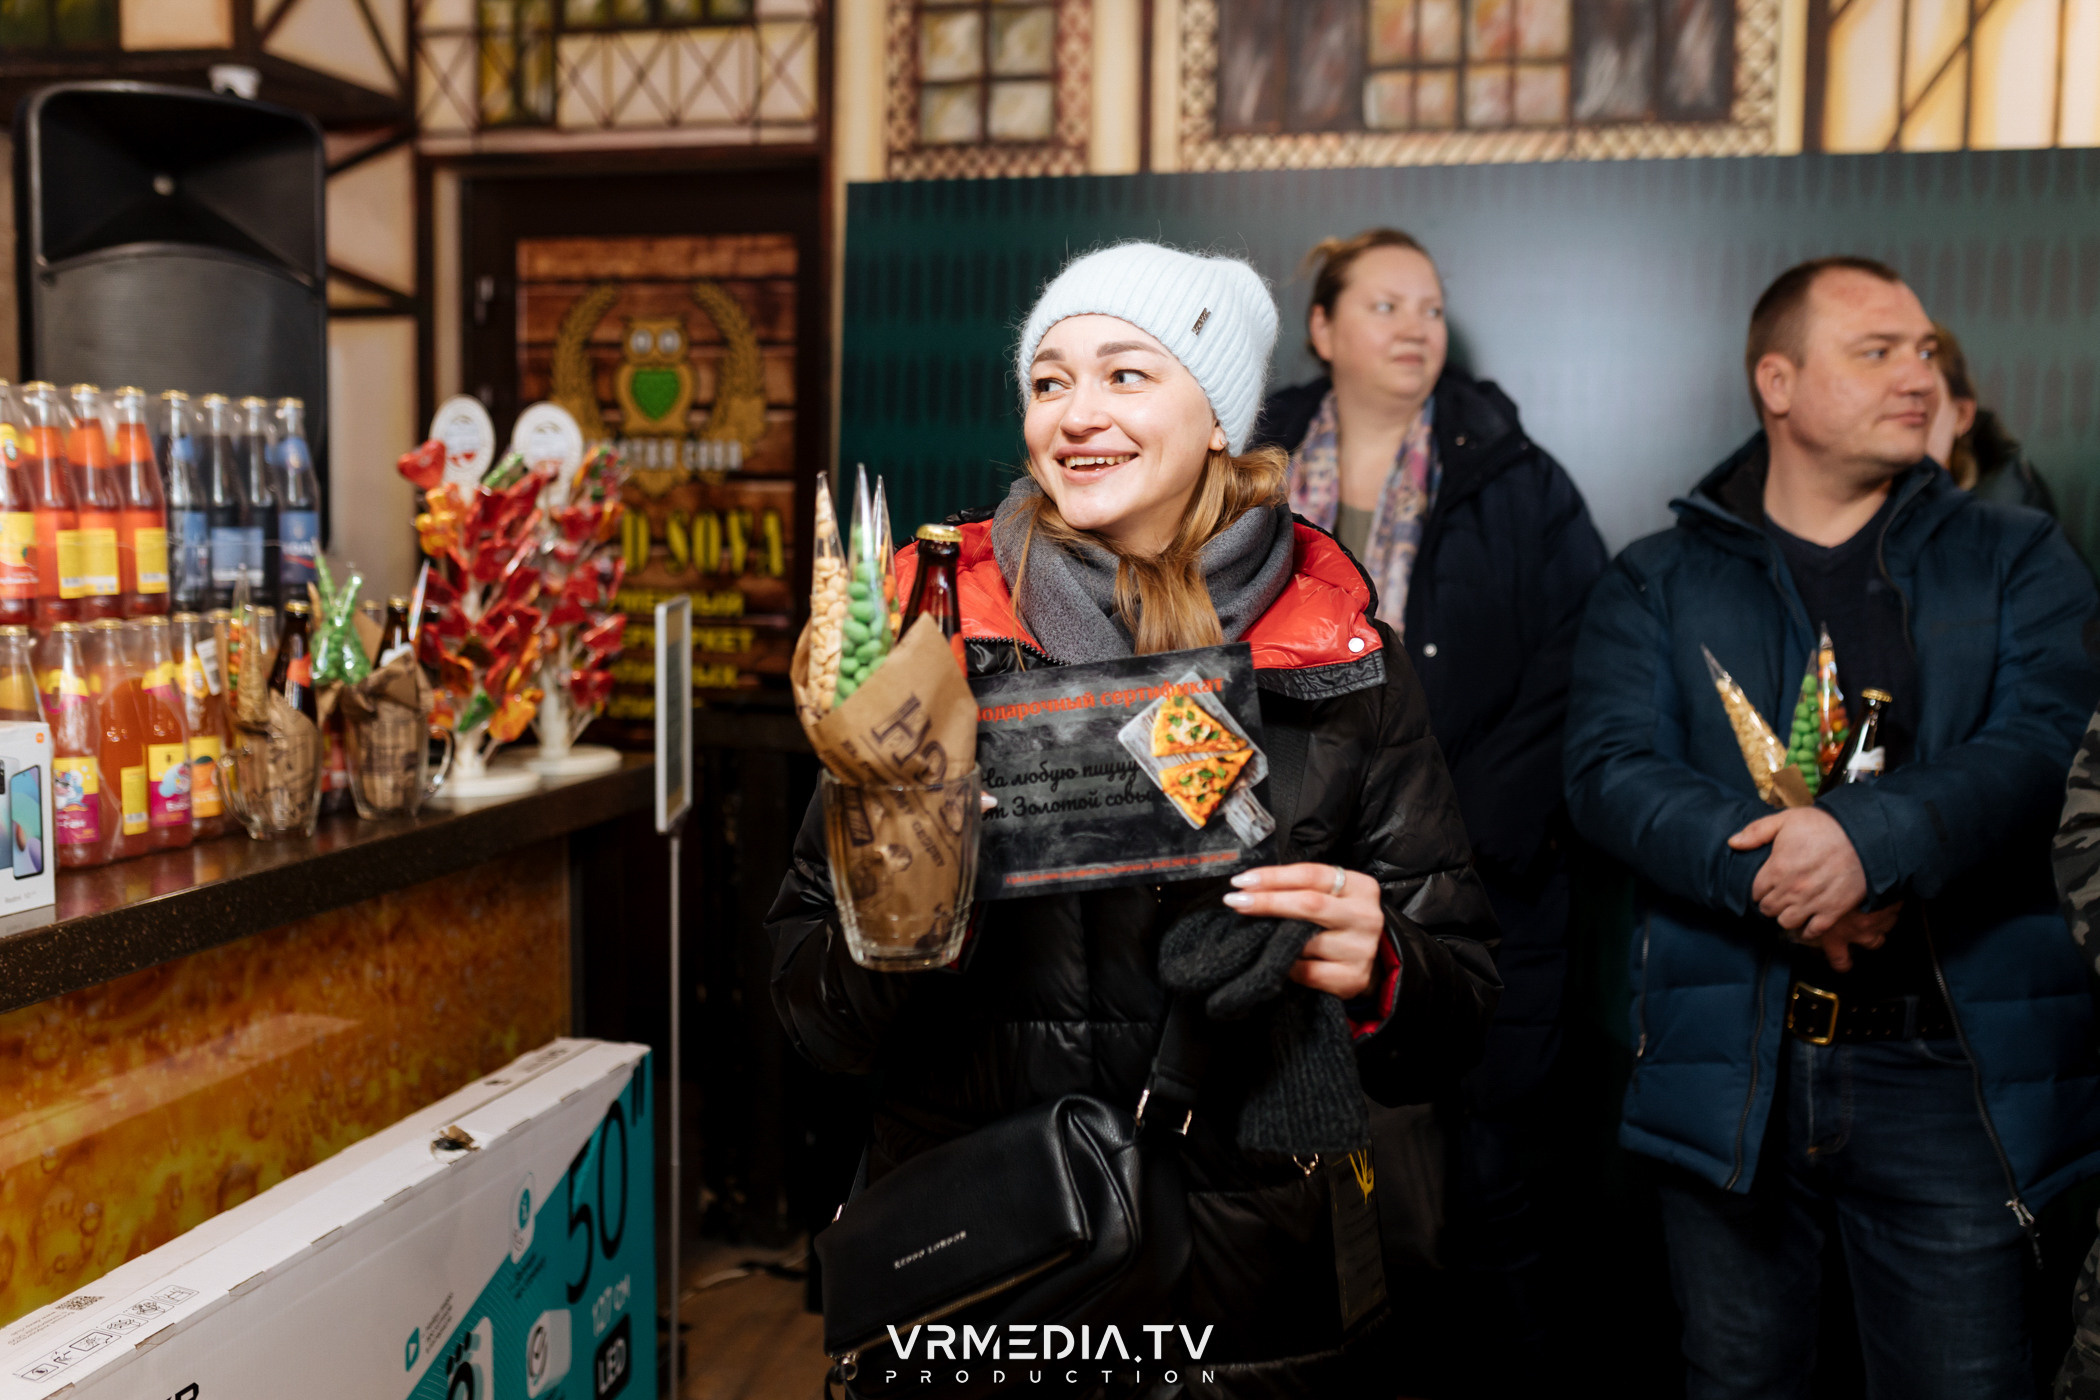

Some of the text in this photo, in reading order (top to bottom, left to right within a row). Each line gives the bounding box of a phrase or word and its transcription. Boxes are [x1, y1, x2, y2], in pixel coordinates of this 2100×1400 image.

[1101, 677, 1224, 708] сертификат
[1011, 761, 1078, 792] любую
[1083, 760, 1140, 783] пиццу
[1012, 791, 1101, 817] Золотой
[1105, 780, 1154, 807] совы
[927, 1230, 967, 1254] LONDON
[597, 1338, 627, 1395] LED
